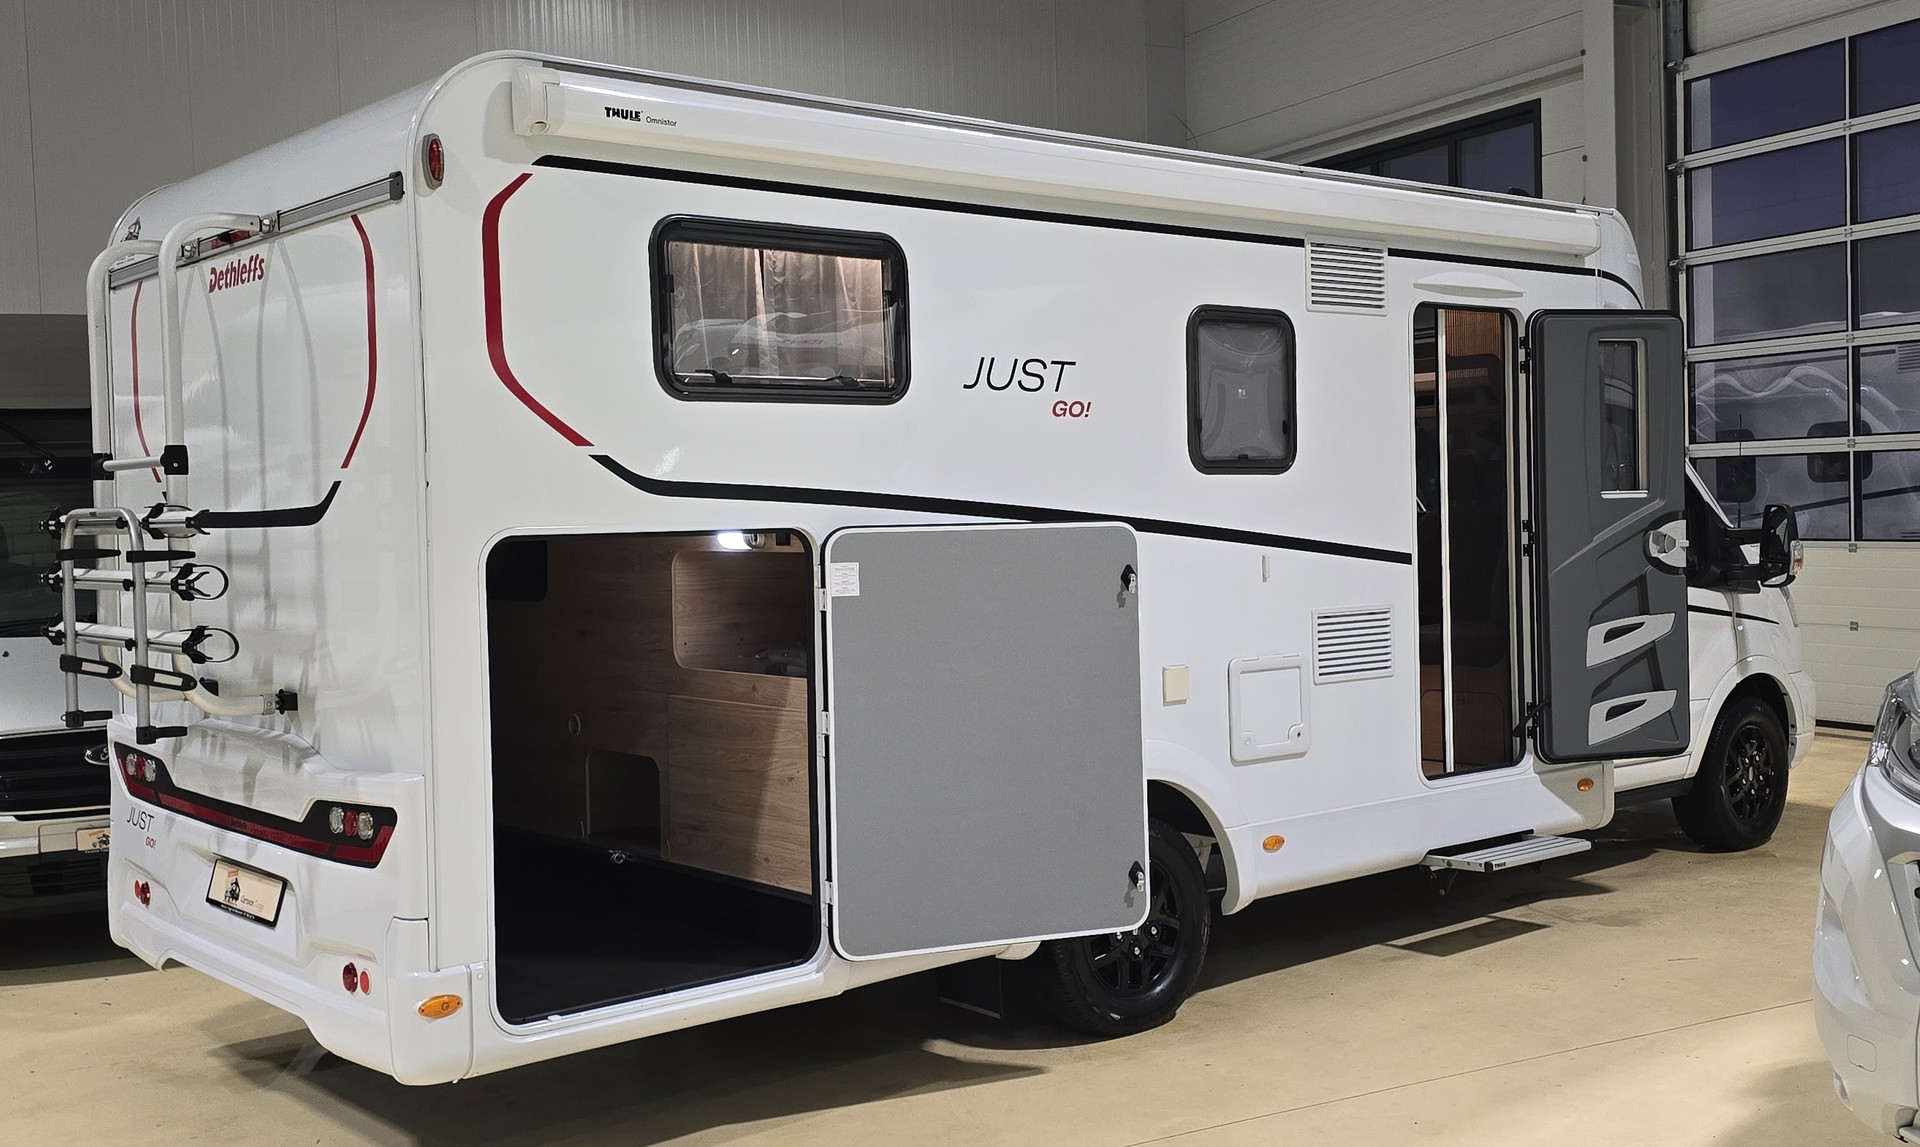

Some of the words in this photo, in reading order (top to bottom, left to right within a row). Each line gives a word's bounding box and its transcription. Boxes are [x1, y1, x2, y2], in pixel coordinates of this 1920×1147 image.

[604, 106, 642, 122] THULE
[645, 115, 678, 127] Omnistor
[208, 253, 265, 294] Dethleffs
[962, 356, 1077, 392] JUST
[1052, 400, 1092, 418] GO!
[126, 806, 155, 832] JUST
[145, 836, 157, 849] GO!
